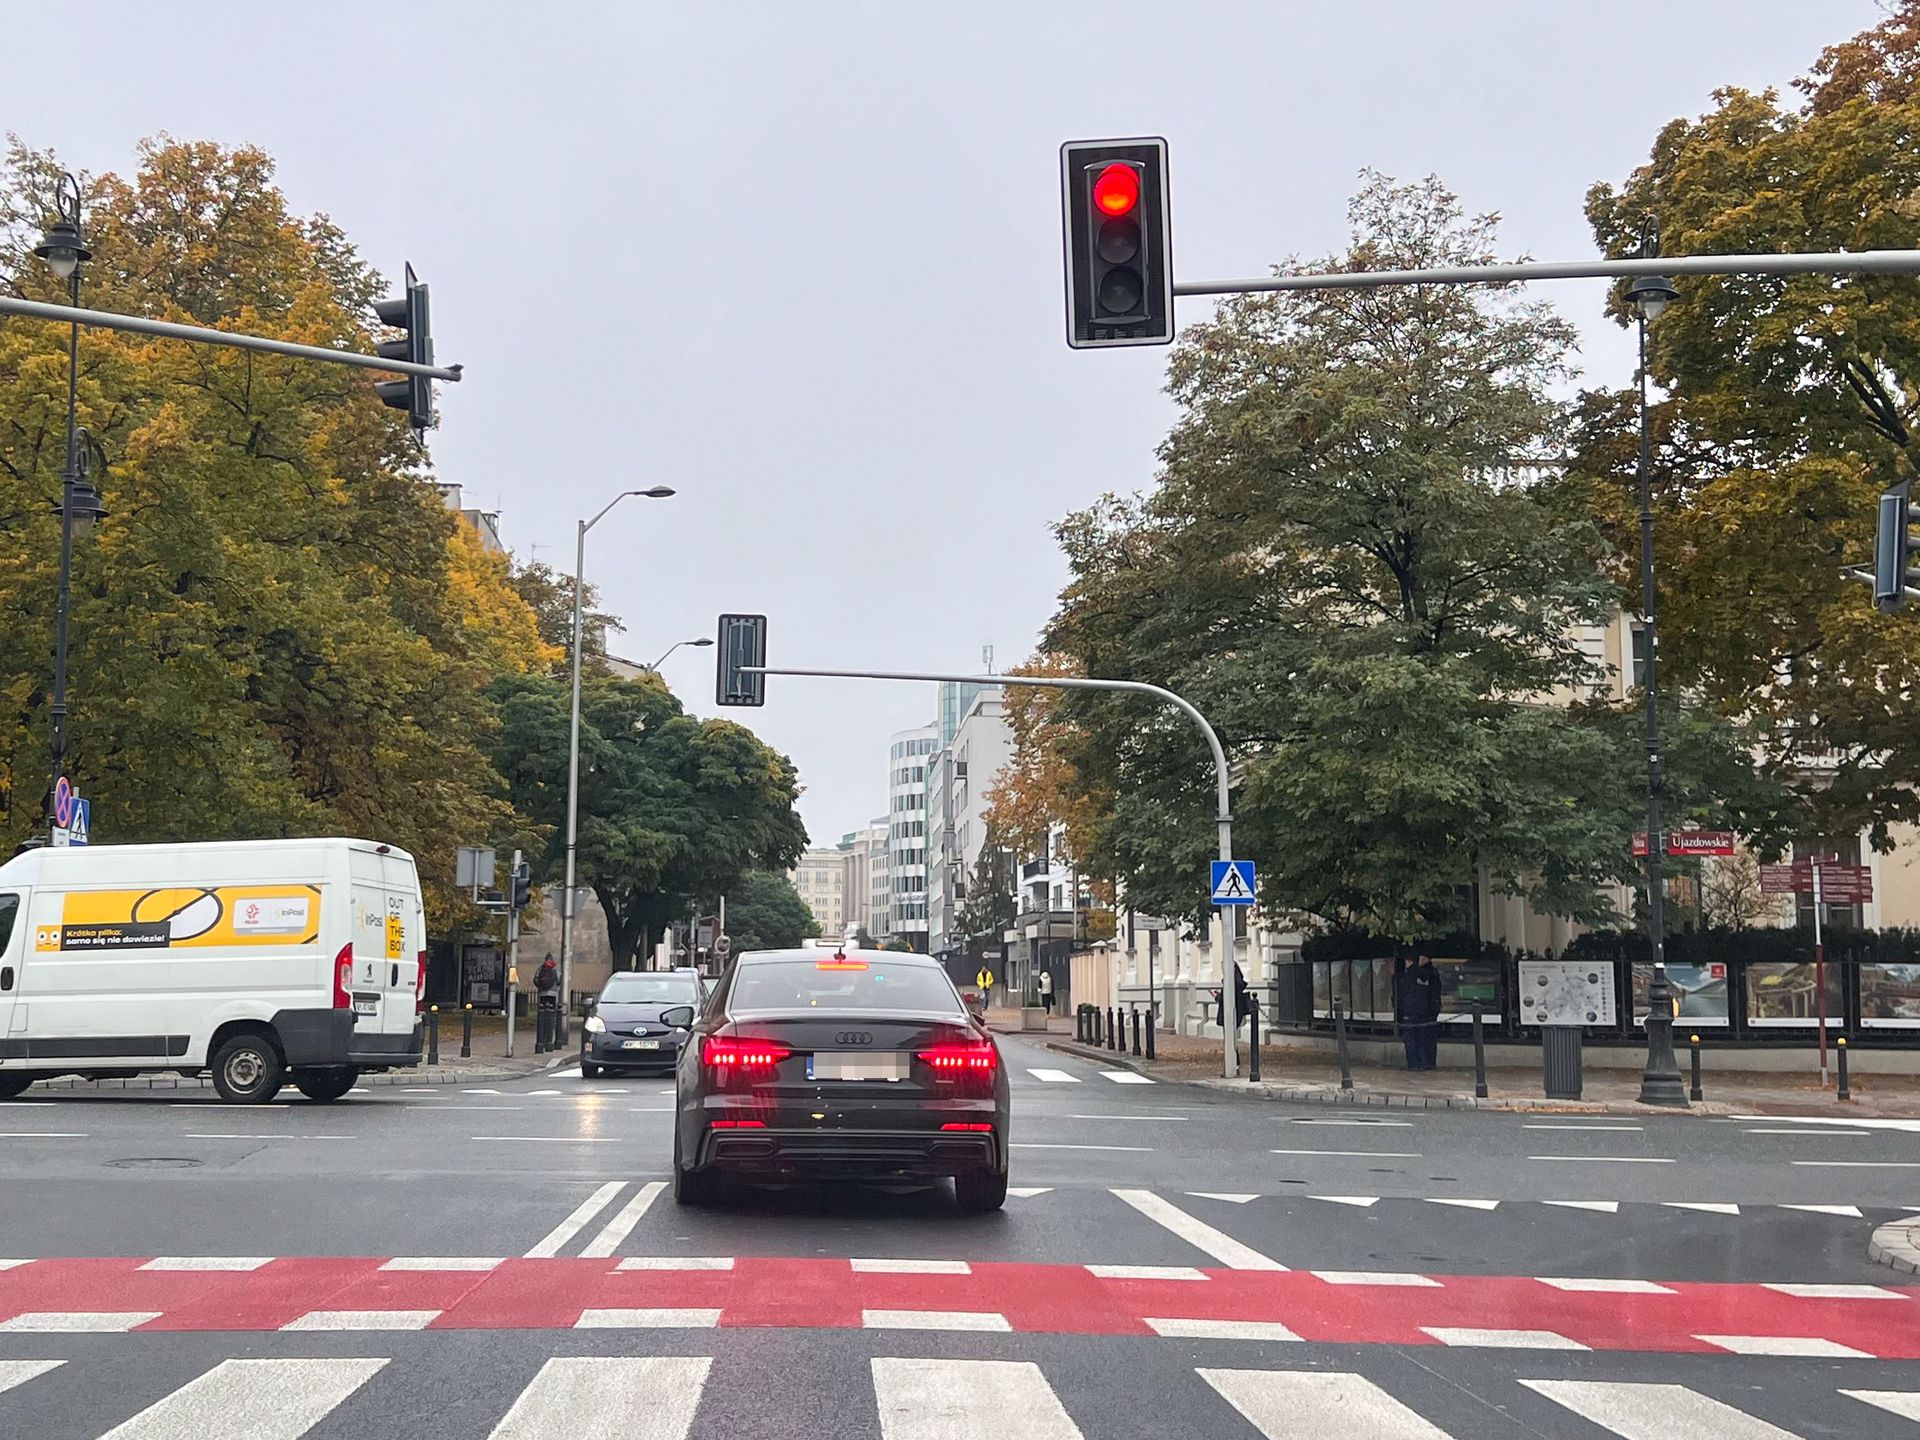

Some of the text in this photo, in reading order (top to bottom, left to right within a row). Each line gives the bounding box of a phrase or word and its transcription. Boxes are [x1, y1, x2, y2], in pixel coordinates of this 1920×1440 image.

[1672, 835, 1729, 849] Ujazdowskie
[389, 897, 404, 909] OUT
[281, 908, 305, 916] InPost
[390, 911, 400, 922] OF
[390, 926, 405, 938] THE
[107, 936, 121, 944] nie
[390, 940, 405, 952] BOX
